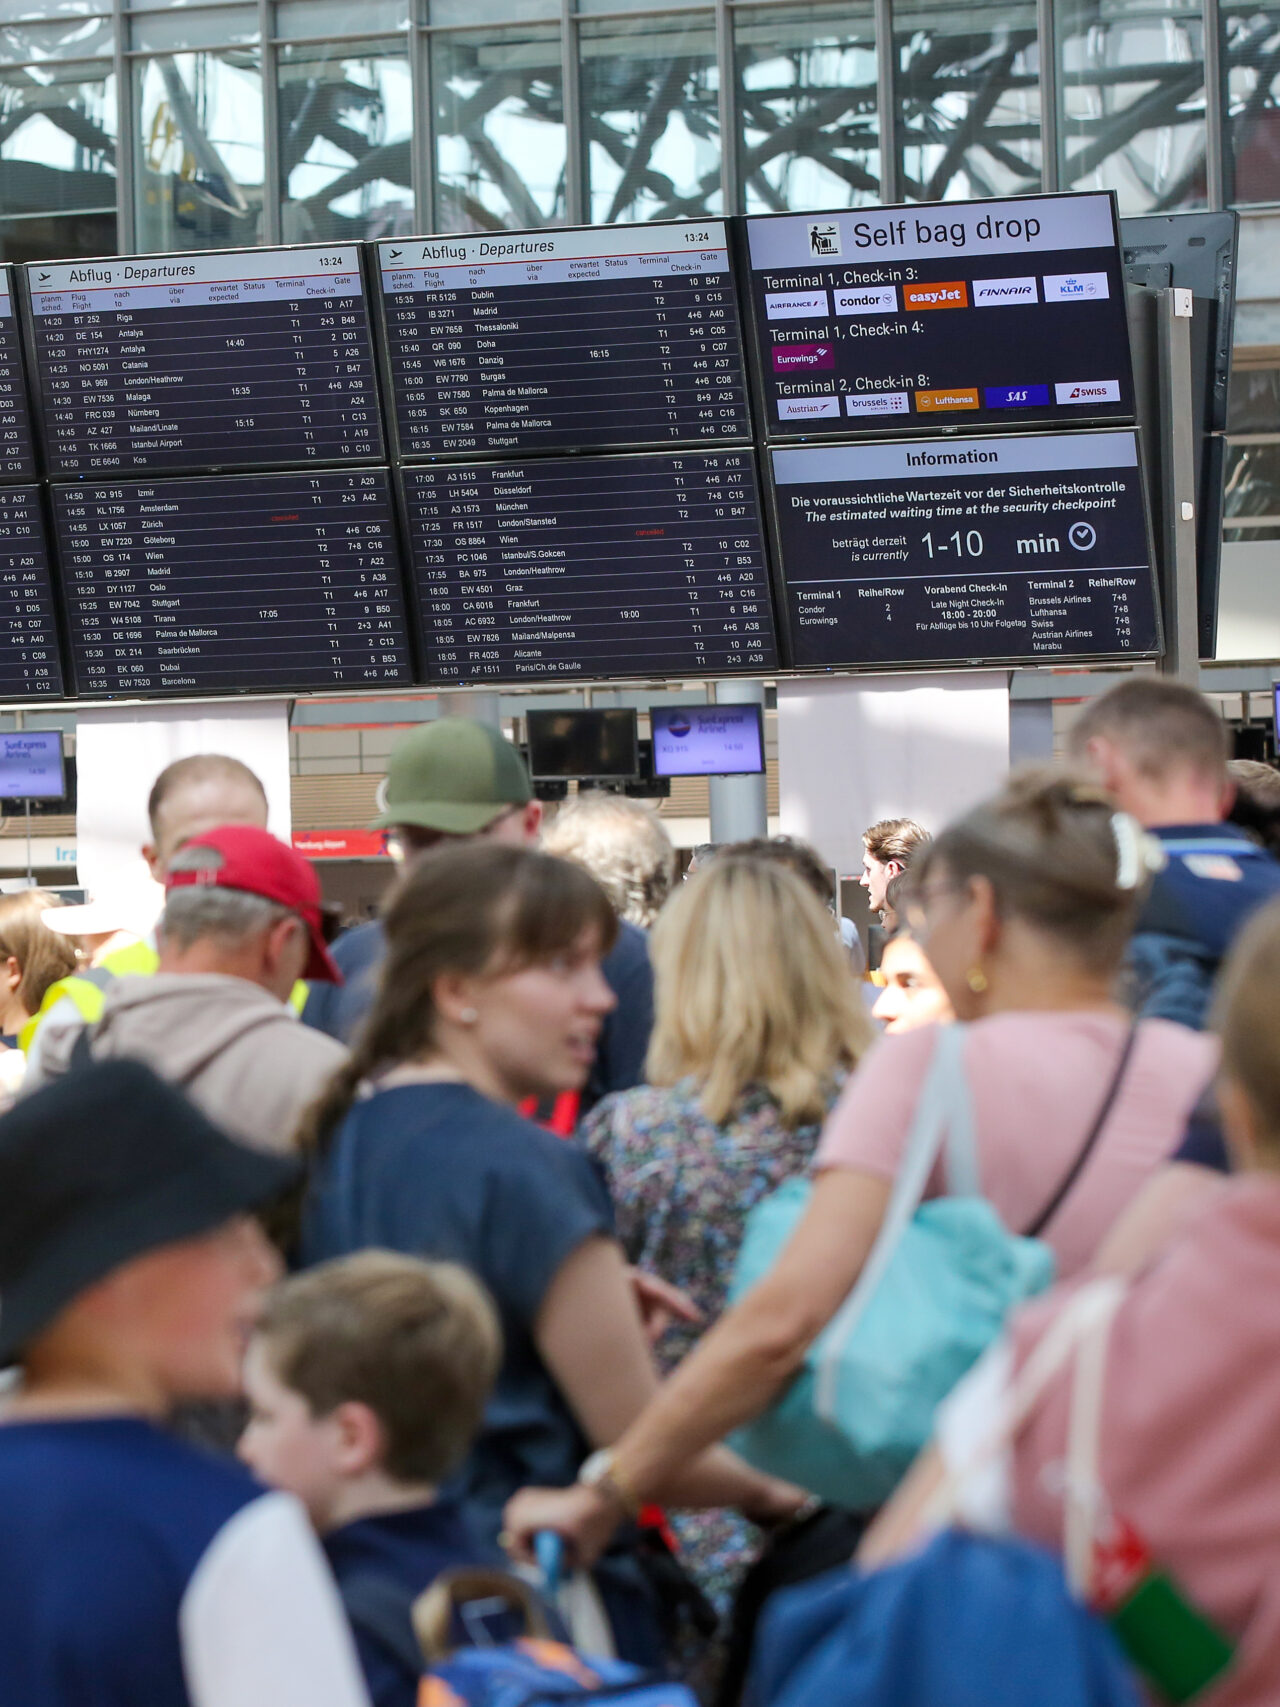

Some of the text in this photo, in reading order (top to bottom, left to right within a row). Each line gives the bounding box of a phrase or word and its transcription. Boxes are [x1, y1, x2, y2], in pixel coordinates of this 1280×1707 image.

[854, 215, 1040, 248] Self bag drop
[685, 232, 709, 242] 13:24
[422, 242, 554, 261] Abflug Departures
[319, 257, 342, 266] 13:24
[638, 256, 670, 265] Terminal
[700, 253, 718, 261] Gate
[569, 261, 600, 269] erwartet
[69, 265, 195, 284] Abflug Departures
[763, 267, 918, 289] Terminal 1, Check-in 3:
[979, 286, 1032, 297] FINNAIR
[1060, 284, 1084, 294] KLM
[840, 295, 881, 307] condor
[910, 289, 961, 303] easyJet
[399, 328, 418, 336] 15:40
[430, 326, 444, 335] EW
[474, 322, 519, 332] Thessaloniki
[656, 313, 666, 321] T1
[688, 311, 702, 319] 4+6
[709, 309, 724, 318] A40
[769, 320, 924, 342] Terminal 1, Check-in 4:
[777, 353, 818, 365] Eurowings
[51, 381, 70, 389] 14:30
[81, 380, 92, 388] BA
[95, 379, 108, 387] 969
[124, 376, 184, 386] London/Heathrow
[296, 367, 306, 375] T2
[347, 364, 361, 373] B47
[775, 374, 930, 395] Terminal 2, Check-in 8:
[1006, 391, 1028, 402] SAS
[1081, 388, 1107, 396] SWISS
[852, 397, 888, 408] brussels
[935, 396, 973, 405] Lufthansa
[786, 405, 819, 414] Austrian
[906, 449, 998, 466] Information
[791, 481, 1126, 507] Die voraussichtliche Wartezeit vor der Sicherheitskontrolle
[805, 497, 1116, 522] The estimated waiting time at the security checkpoint
[421, 507, 745, 531] 17:25 FR 1517 London/Stansted T2 10 B47
[832, 535, 907, 549] beträgt derzeit
[921, 530, 1060, 558] 1-10 min
[851, 549, 909, 562] is currently
[1027, 580, 1067, 589] Terminal
[1088, 577, 1136, 587] Reihe/Row
[858, 588, 905, 597] Reihe/Row
[924, 583, 1008, 594] Vorabend Check-In
[796, 590, 835, 600] Terminal
[1029, 595, 1092, 605] Brussels Airlines
[1112, 593, 1127, 602] 7+8
[26, 604, 40, 612] D05
[931, 598, 1005, 609] Late Night Check-In
[798, 605, 825, 614] Condor
[941, 609, 997, 619] 18:00 20:00
[1030, 608, 1067, 617] Lufthansa
[1113, 605, 1129, 613] 7+8
[799, 617, 838, 626] Eurowings
[929, 622, 957, 631] Abflüge
[970, 620, 979, 628] 10
[980, 620, 994, 628] Uhr
[995, 619, 1027, 629] Folgetag
[1031, 620, 1054, 628] Swiss
[1115, 616, 1130, 624] 7+8
[1032, 630, 1093, 639] Austrian Airlines
[1116, 627, 1131, 636] 7+8
[85, 649, 104, 657] 15:30
[129, 648, 142, 656] 214
[158, 646, 200, 655] Saarbrücken
[329, 640, 339, 648] T1
[379, 638, 394, 646] C13
[1033, 642, 1062, 650] Marabu
[1120, 639, 1130, 647] 10
